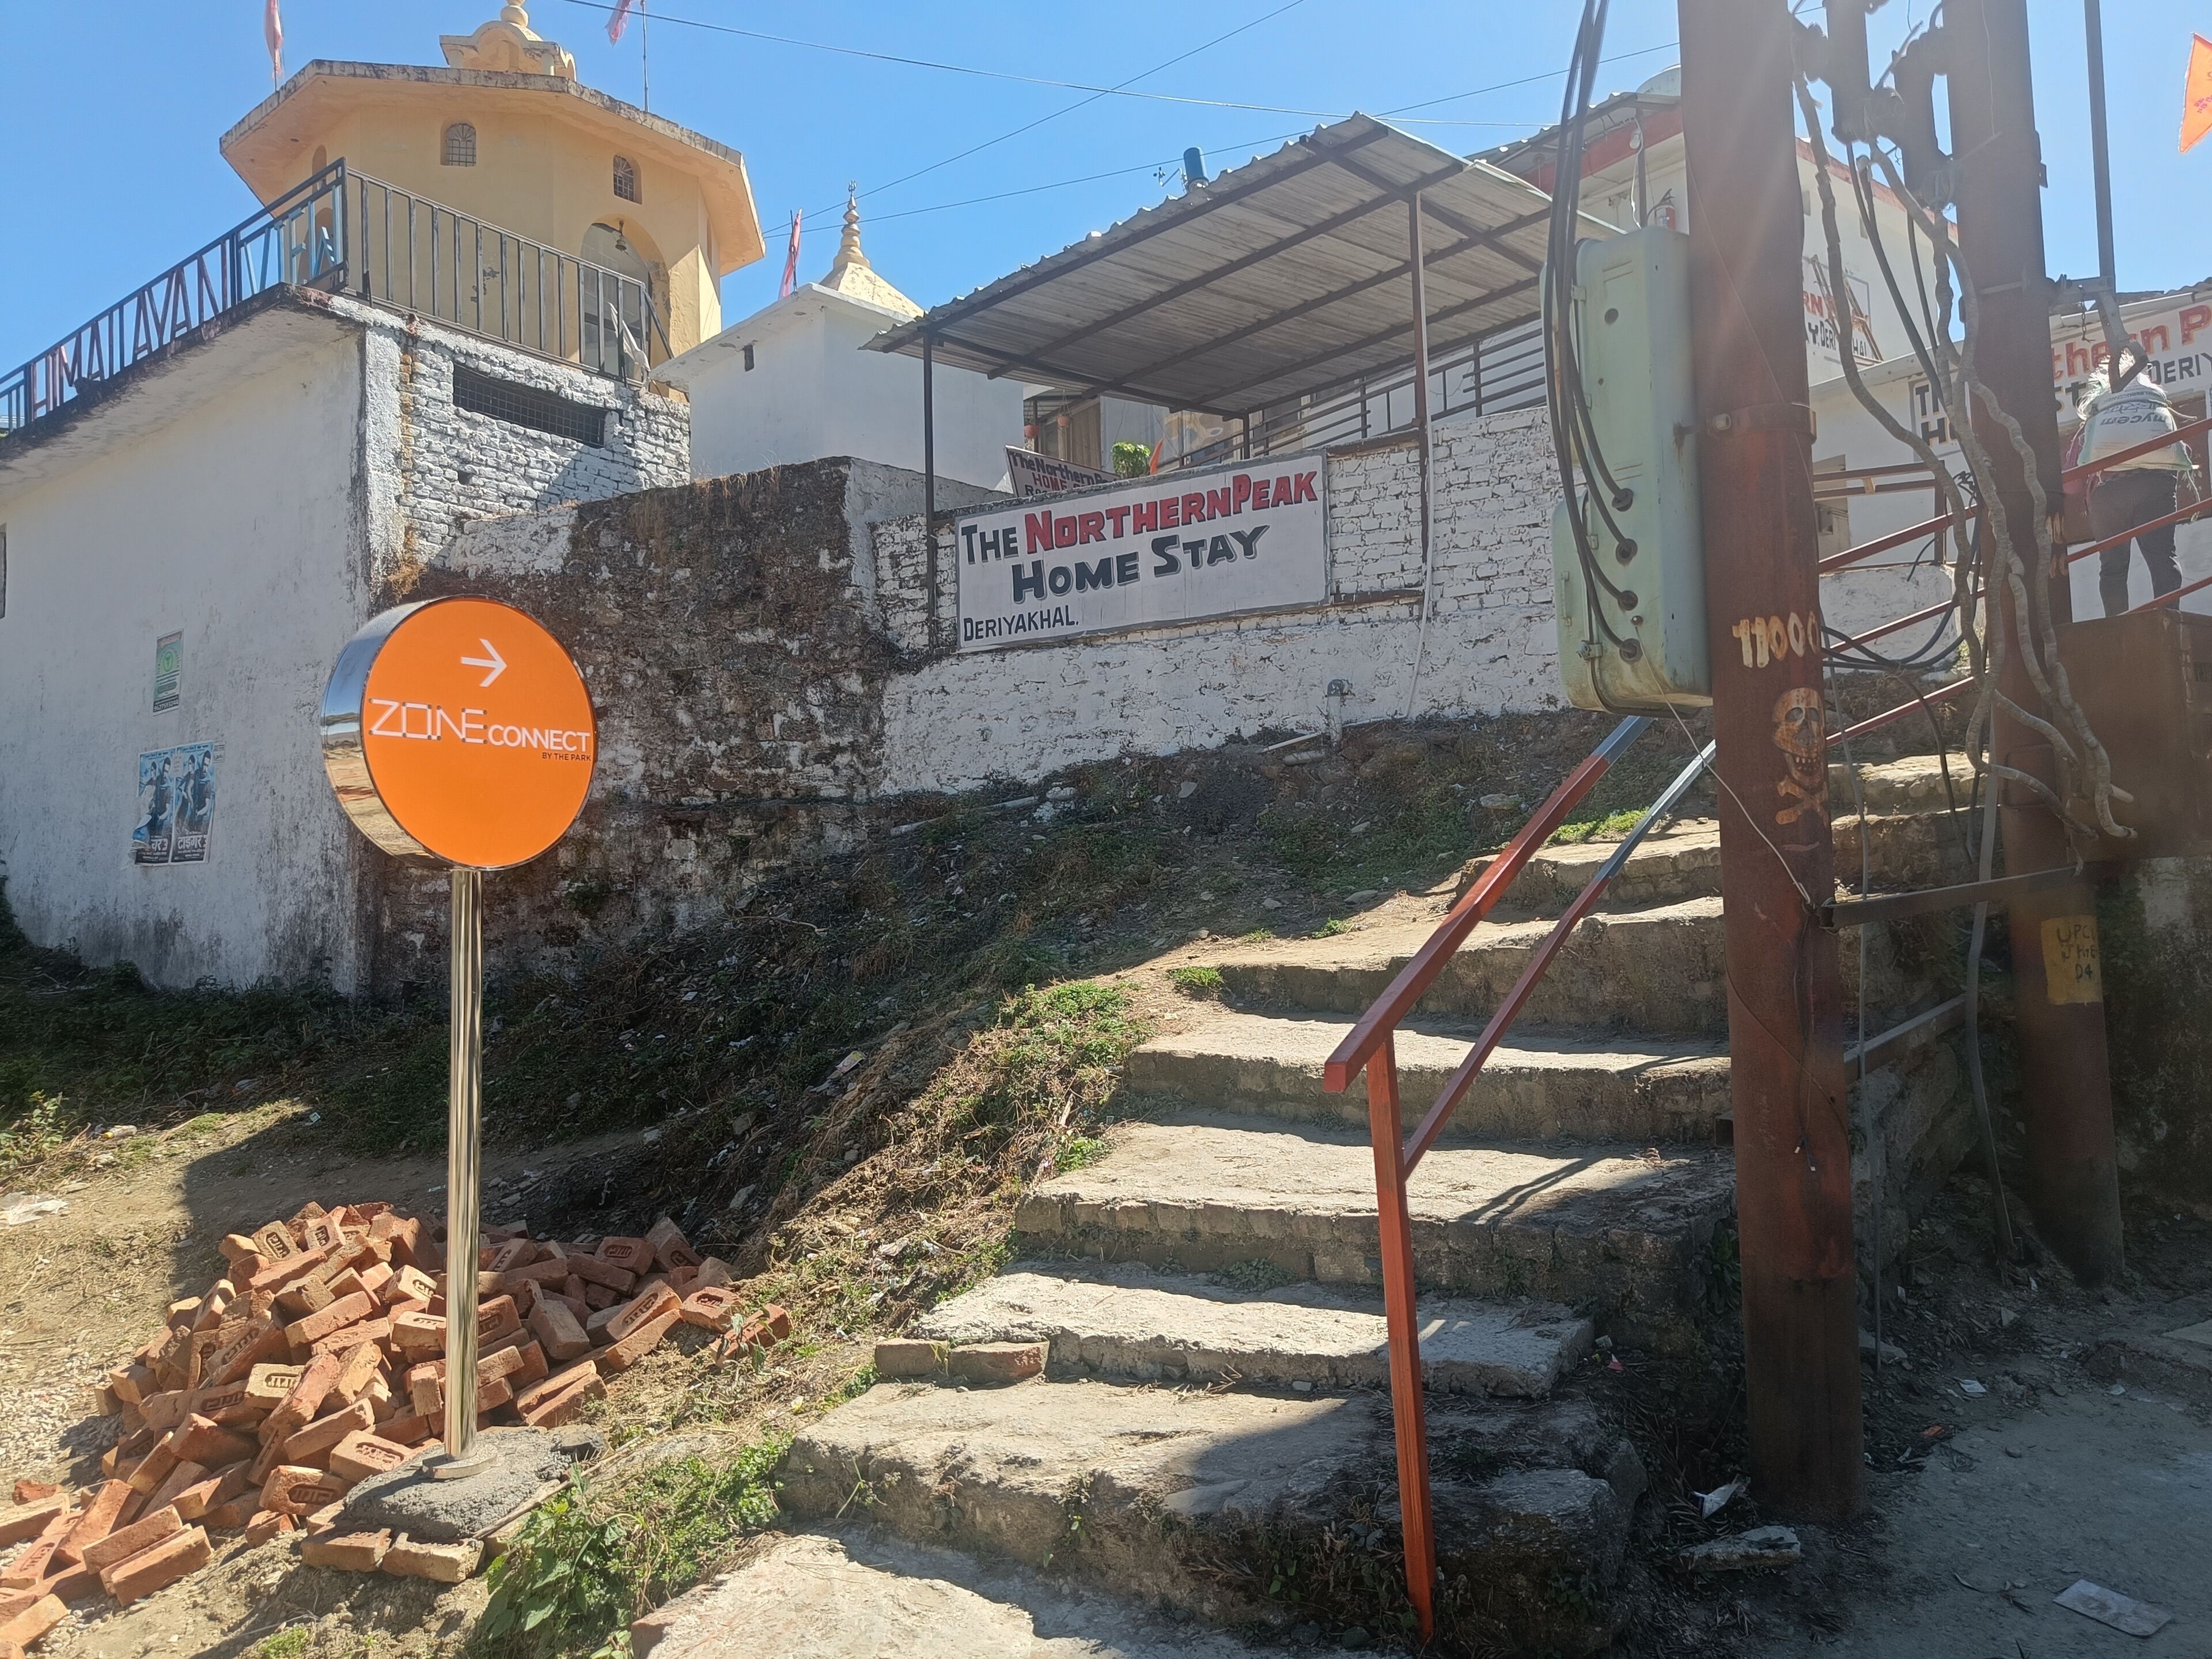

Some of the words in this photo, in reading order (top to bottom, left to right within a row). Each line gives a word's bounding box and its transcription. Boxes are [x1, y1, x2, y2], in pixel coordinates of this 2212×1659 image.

[961, 524, 1020, 565] THE
[1012, 551, 1141, 604] HOME
[1152, 525, 1271, 578] STAY
[369, 698, 488, 745] ZONE
[487, 724, 591, 752] CONNECT
